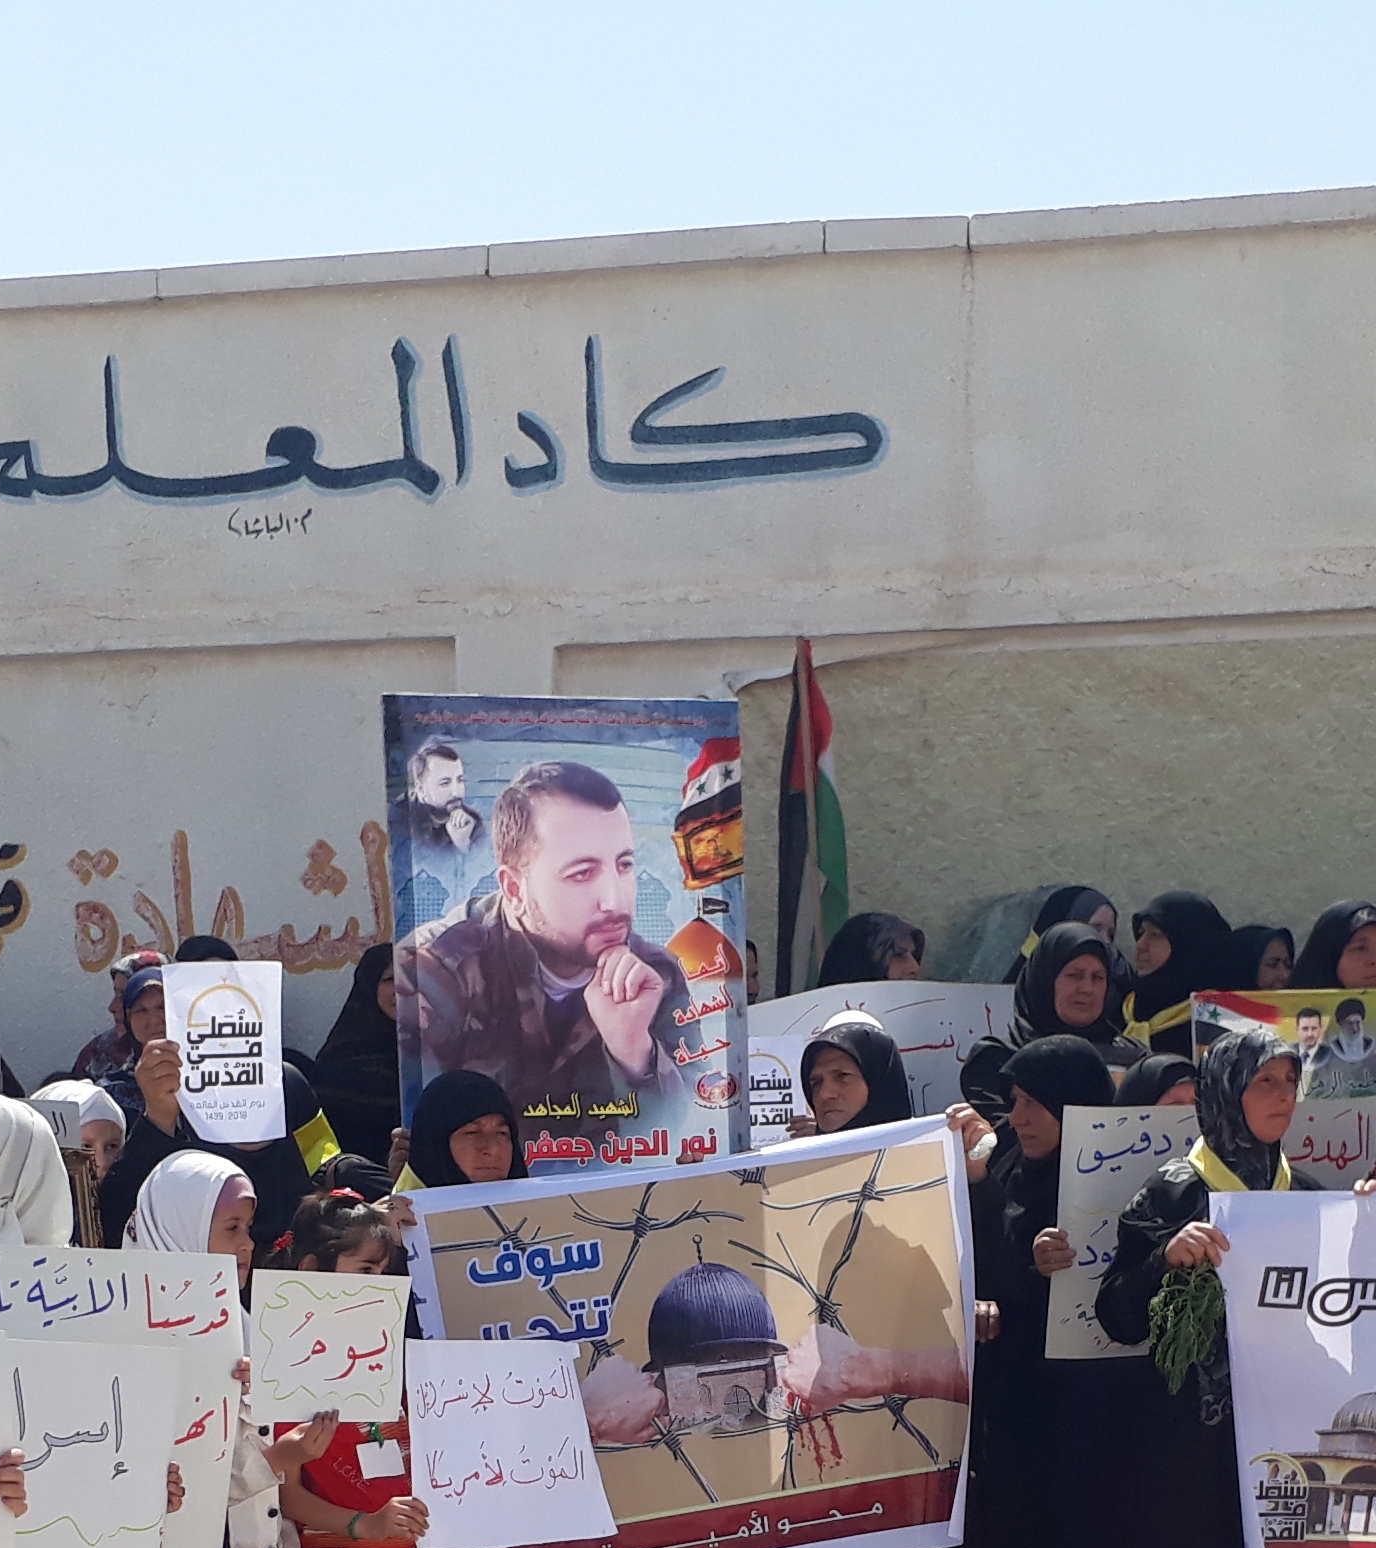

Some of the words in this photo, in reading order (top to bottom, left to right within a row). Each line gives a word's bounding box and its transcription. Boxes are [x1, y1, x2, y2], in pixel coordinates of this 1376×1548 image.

[504, 333, 889, 493] كاد
[673, 984, 735, 1026] الشهادة
[187, 1040, 262, 1070] في
[675, 1036, 731, 1066] حياة
[523, 1093, 581, 1119] المجاهد
[587, 1092, 640, 1119] الشهيد
[524, 1131, 595, 1166] جعفر
[601, 1130, 669, 1165] الدين
[677, 1128, 718, 1161] نور
[467, 1237, 602, 1289] سوف
[13, 1367, 129, 1480] إسرا
[777, 1500, 885, 1536] محو
